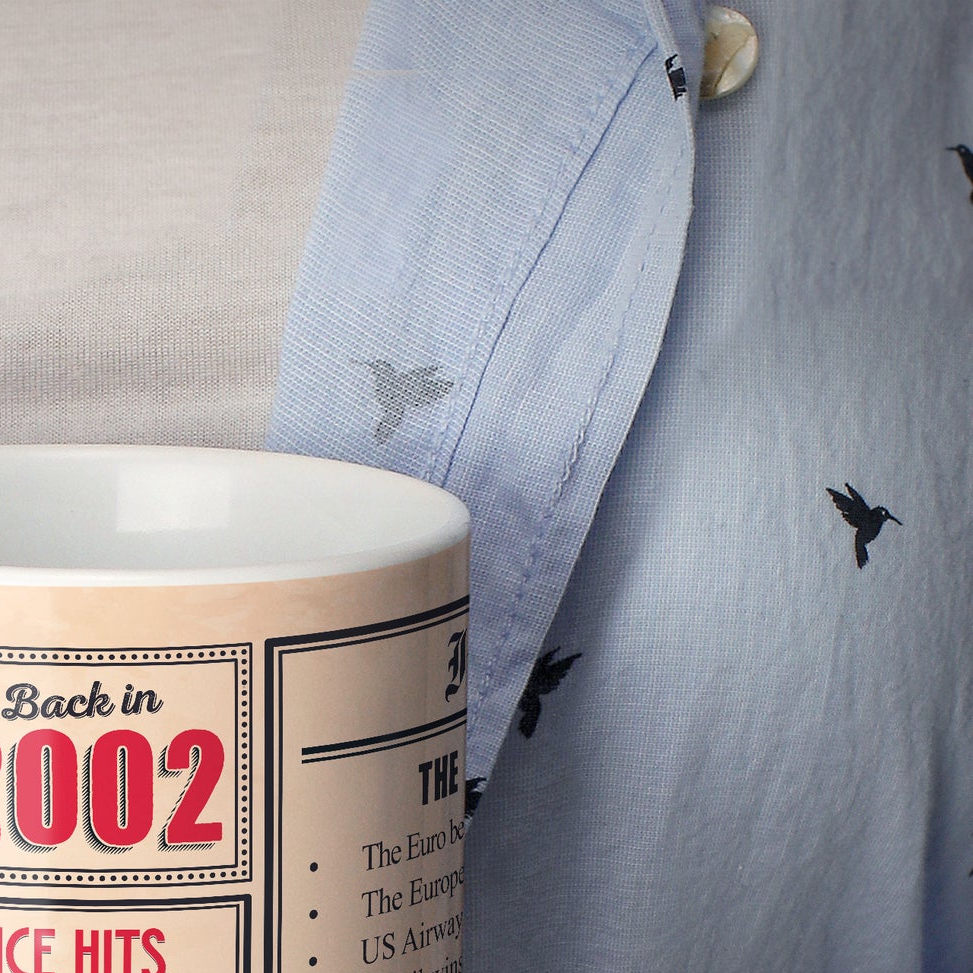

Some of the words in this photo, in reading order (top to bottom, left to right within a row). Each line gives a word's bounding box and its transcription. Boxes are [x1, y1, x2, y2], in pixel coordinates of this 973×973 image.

[1, 681, 116, 722] Back
[121, 684, 163, 716] in
[419, 750, 458, 805] THE
[362, 841, 402, 871] The
[406, 832, 446, 862] Euro
[361, 888, 403, 918] The
[361, 932, 396, 965] US
